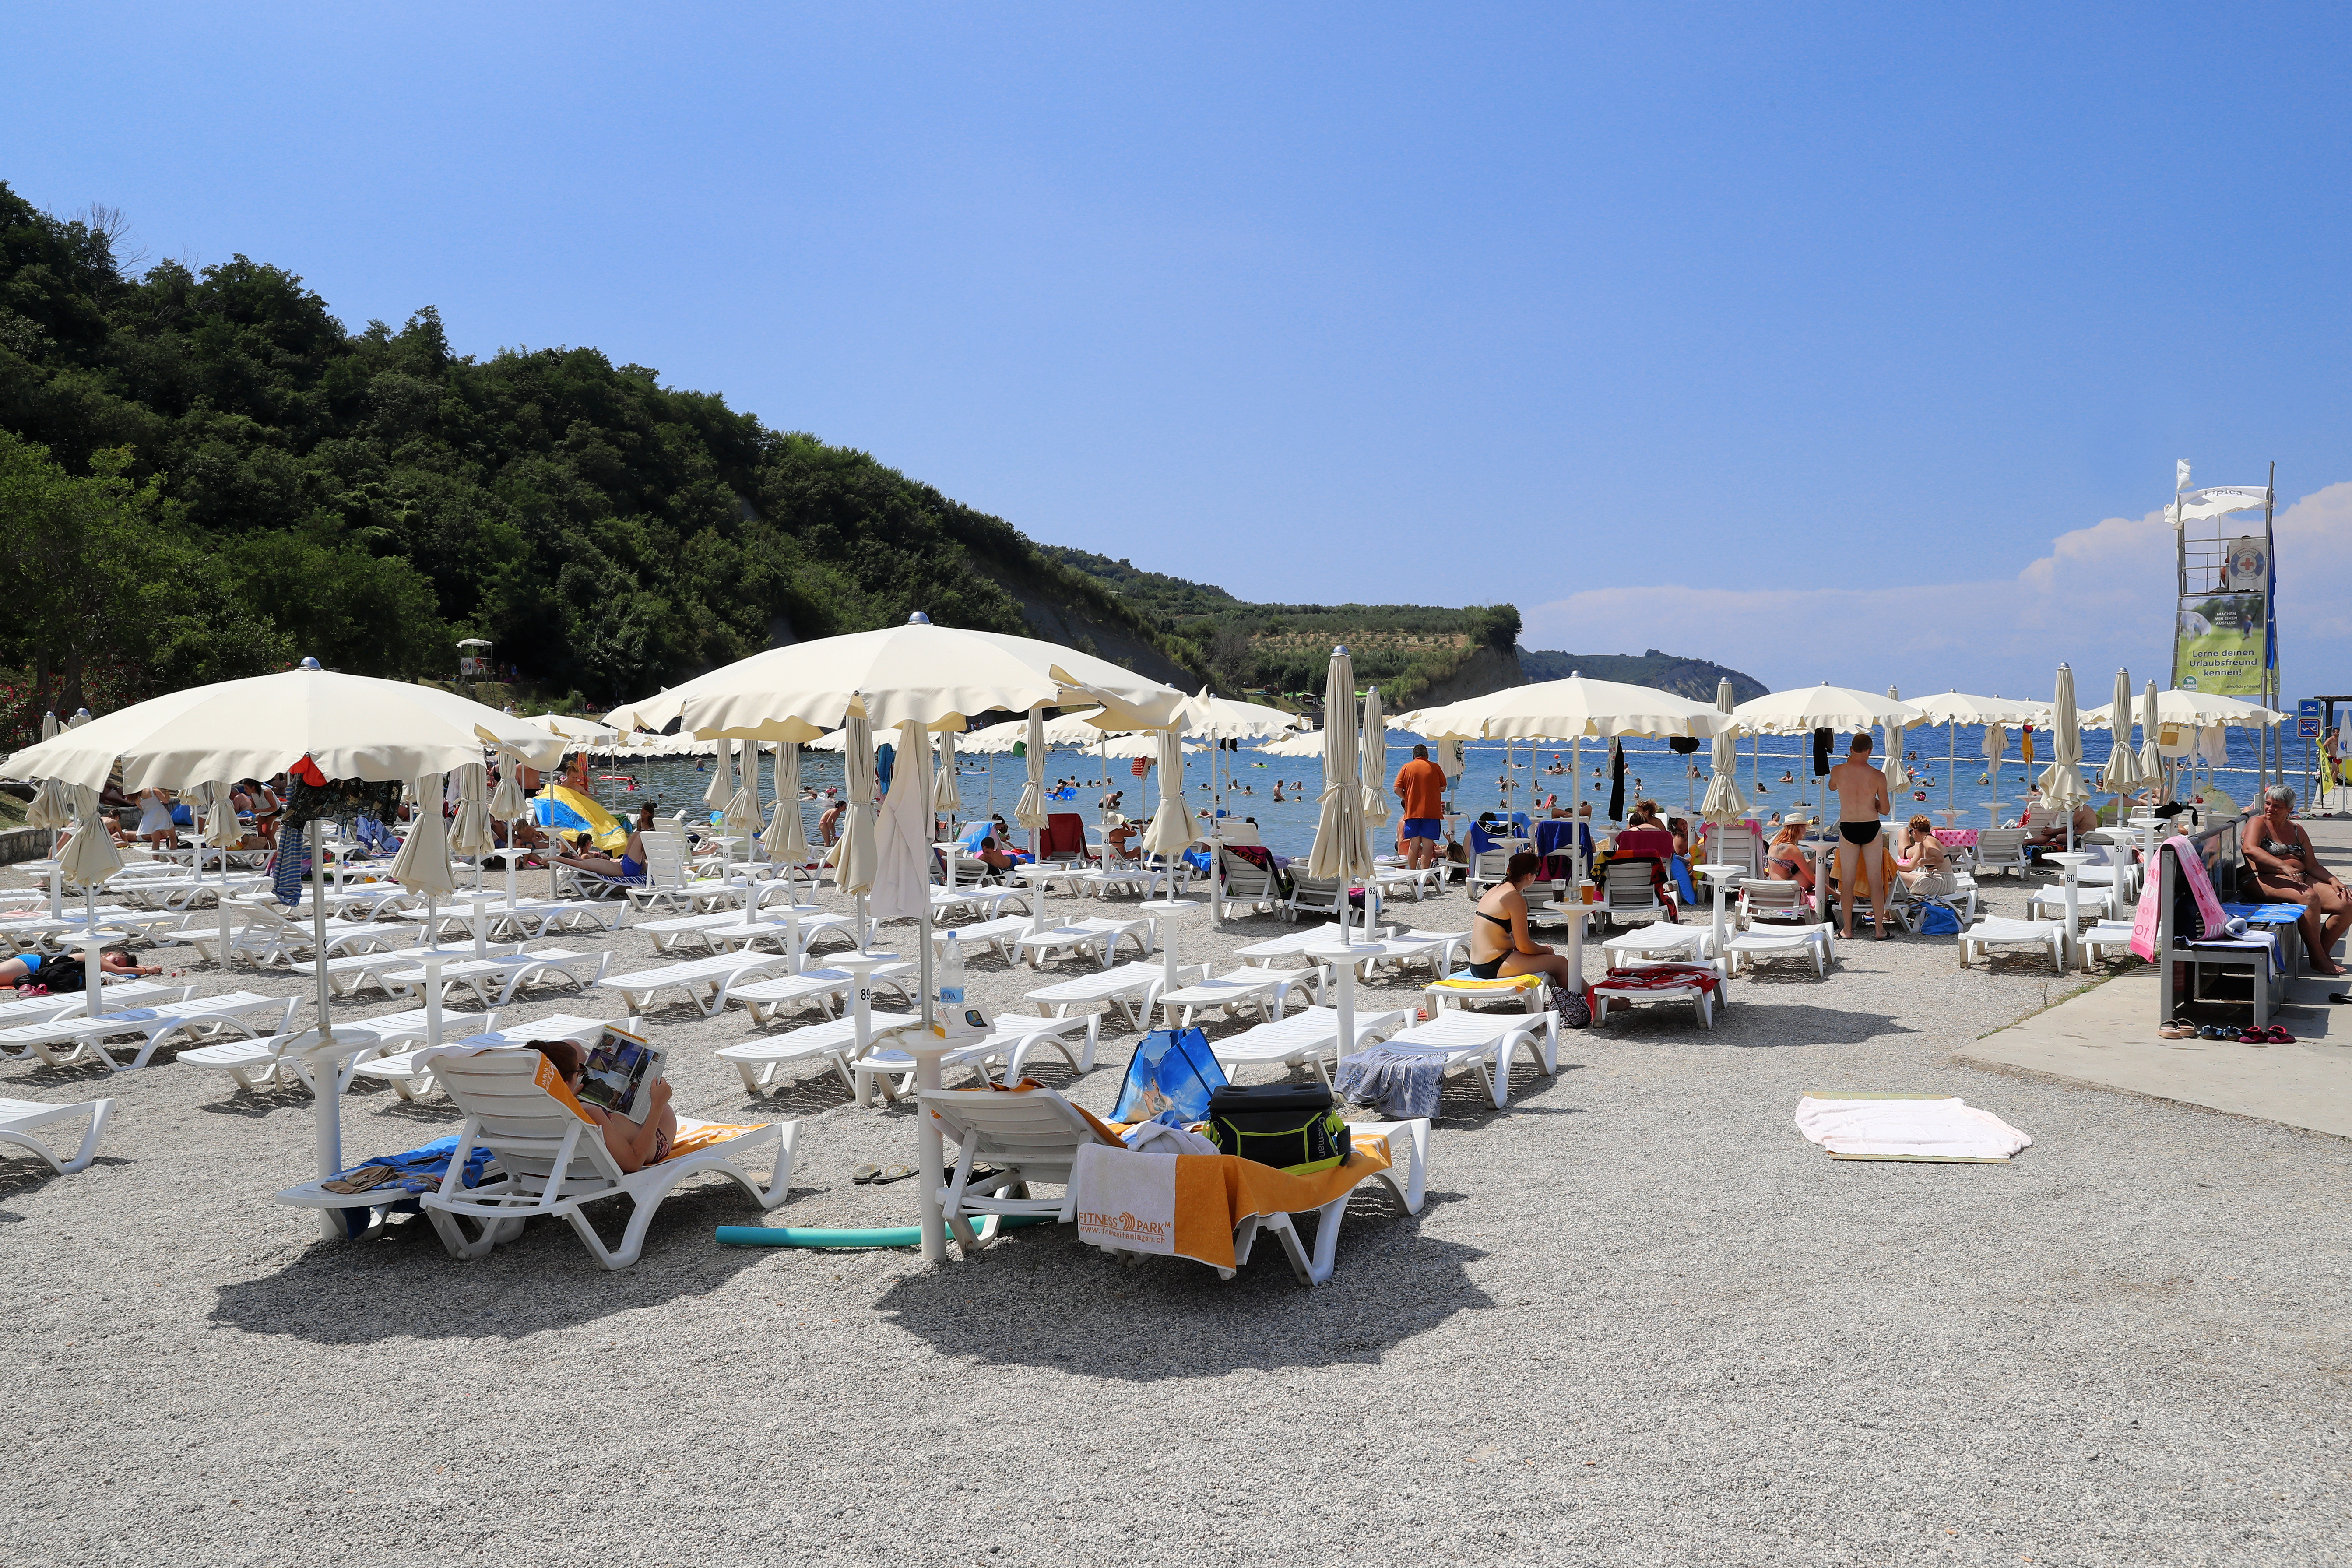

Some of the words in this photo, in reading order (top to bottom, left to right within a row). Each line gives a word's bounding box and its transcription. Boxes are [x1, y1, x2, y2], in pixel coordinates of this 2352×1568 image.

[2190, 658, 2257, 667] Urlaubsfreund
[1236, 851, 1261, 866] AZUR
[861, 988, 870, 1000] 89
[1079, 1212, 1118, 1227] FITNESS
[1137, 1220, 1164, 1234] PARK
[1079, 1226, 1165, 1244] www.freizeitanlagen.ch
